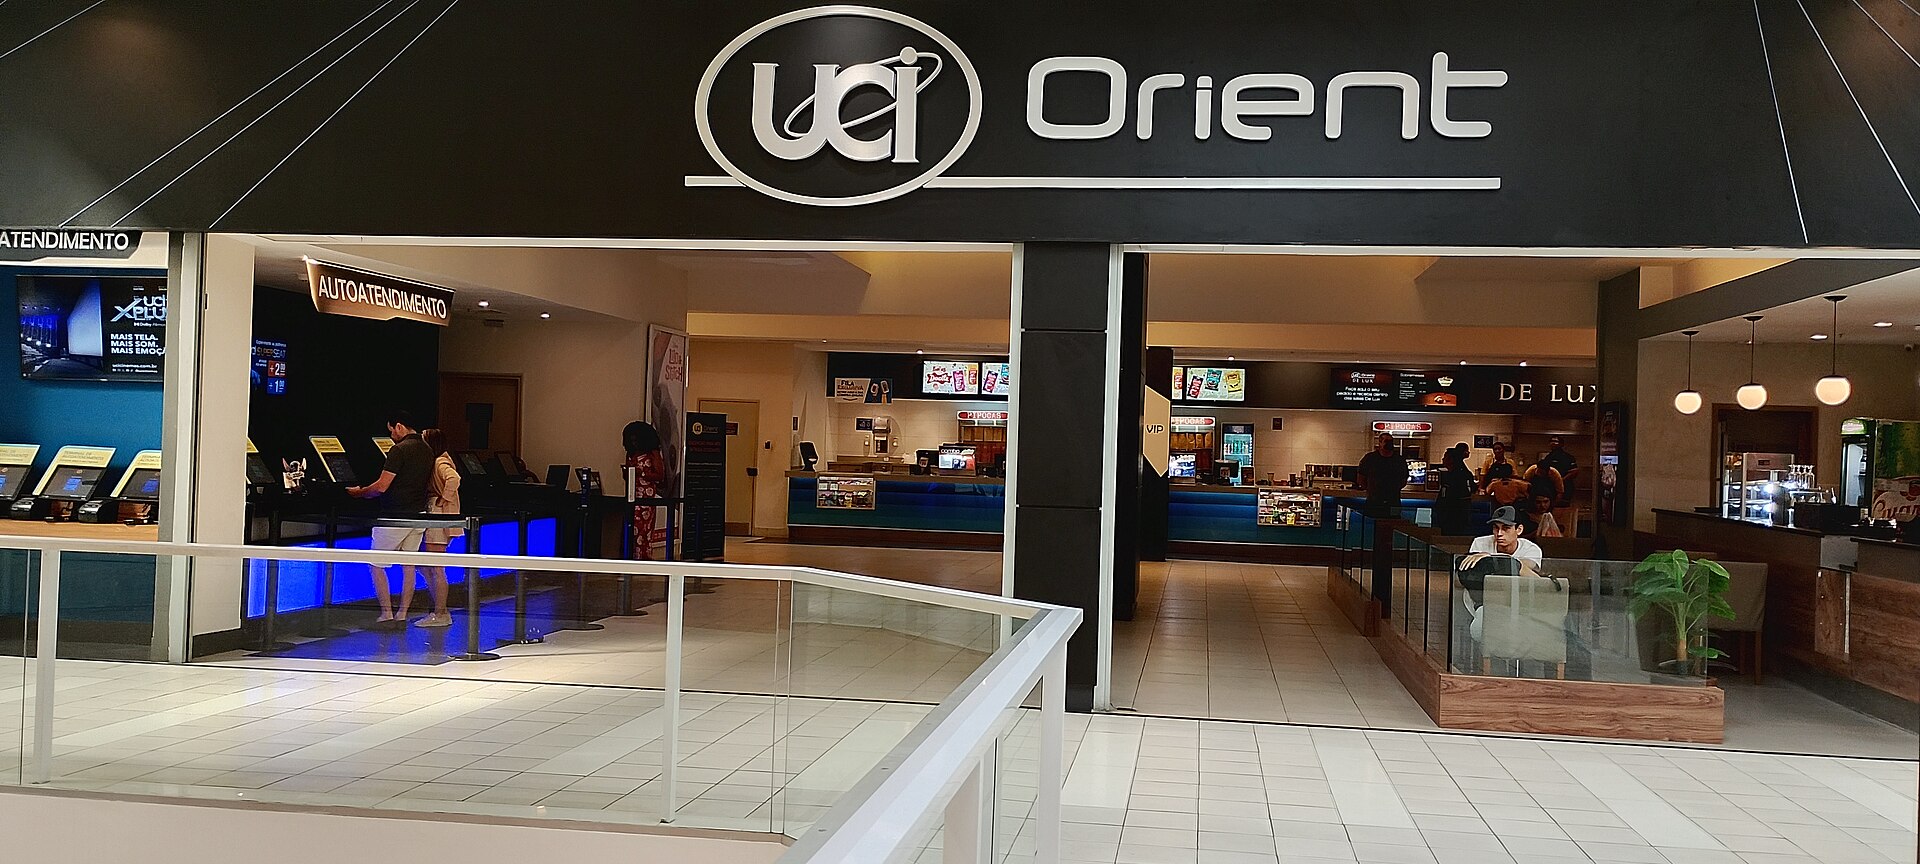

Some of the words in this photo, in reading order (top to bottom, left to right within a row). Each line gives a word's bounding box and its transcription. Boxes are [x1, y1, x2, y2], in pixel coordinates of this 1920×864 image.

[1027, 51, 1509, 140] Orient
[318, 274, 448, 319] AUTOATENDIMENTO
[134, 333, 159, 341] TELA.
[134, 340, 159, 348] SOM.
[1499, 382, 1532, 401] DE
[966, 411, 1002, 419] PIPOCAS
[1146, 424, 1164, 434] VIP
[1384, 423, 1422, 431] PIPOCAS
